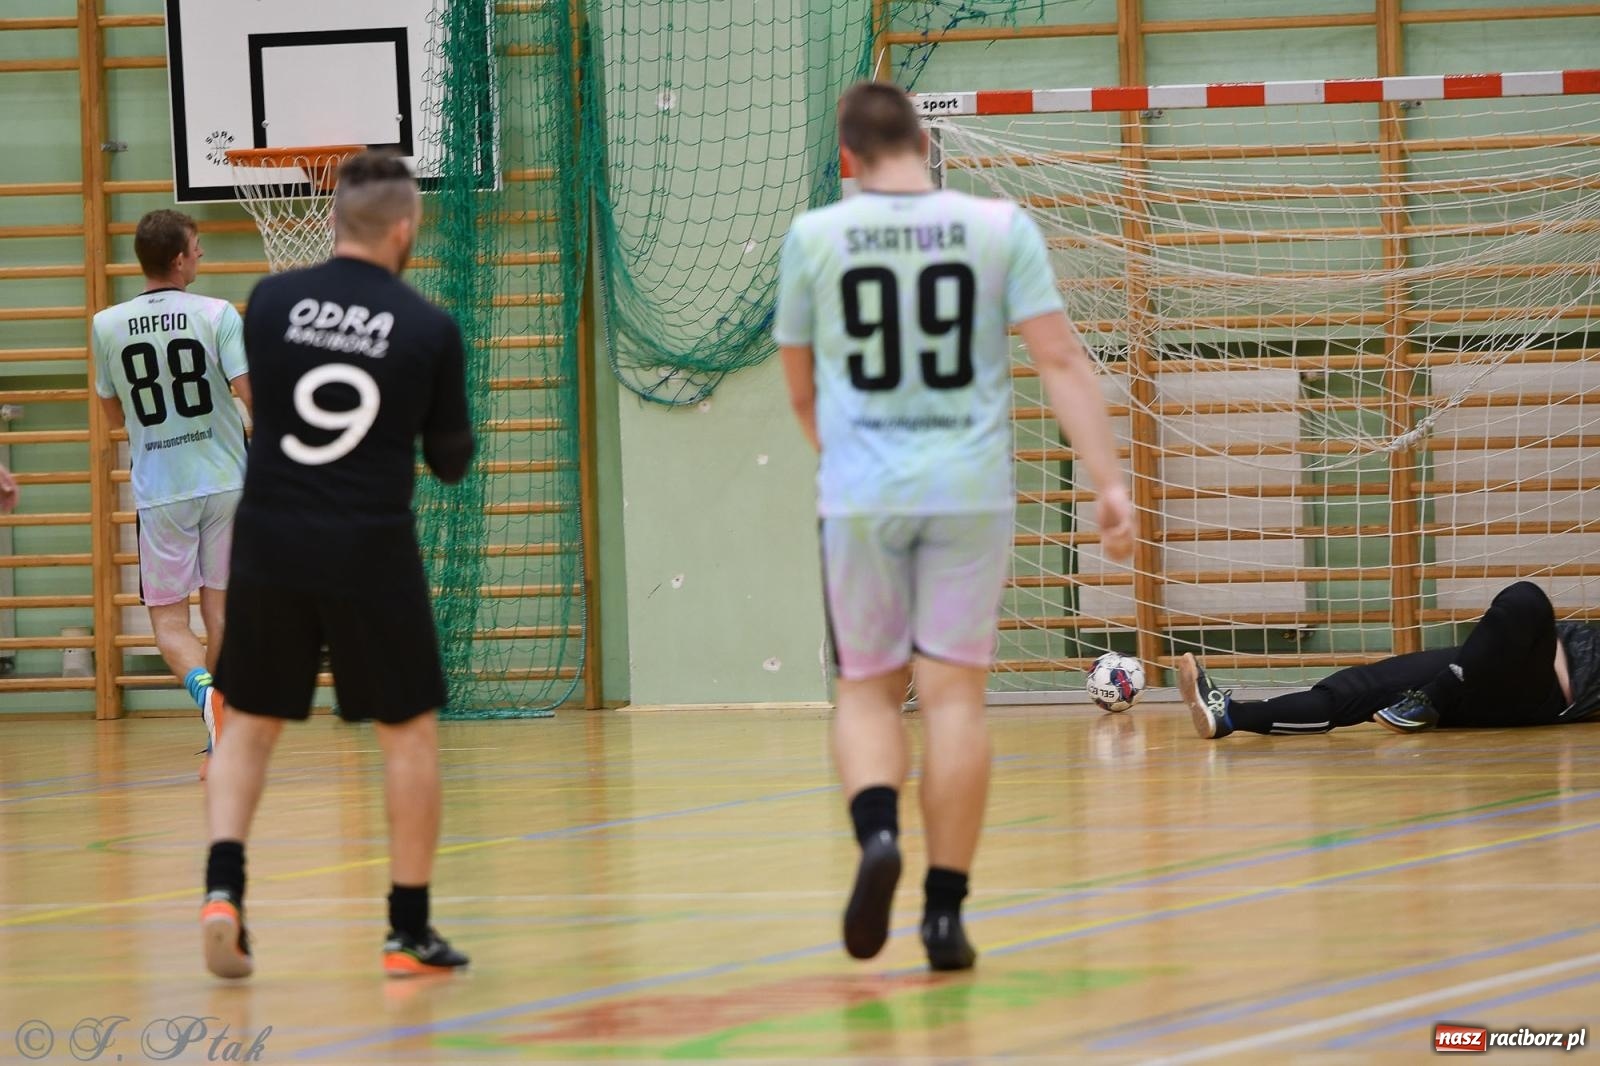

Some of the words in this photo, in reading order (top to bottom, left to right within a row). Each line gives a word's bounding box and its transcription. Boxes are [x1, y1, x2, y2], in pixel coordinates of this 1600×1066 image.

[128, 313, 187, 336] RAFCIO
[289, 298, 395, 341] ODRA
[841, 262, 975, 391] 99
[121, 338, 214, 427] 88
[280, 362, 380, 466] 9
